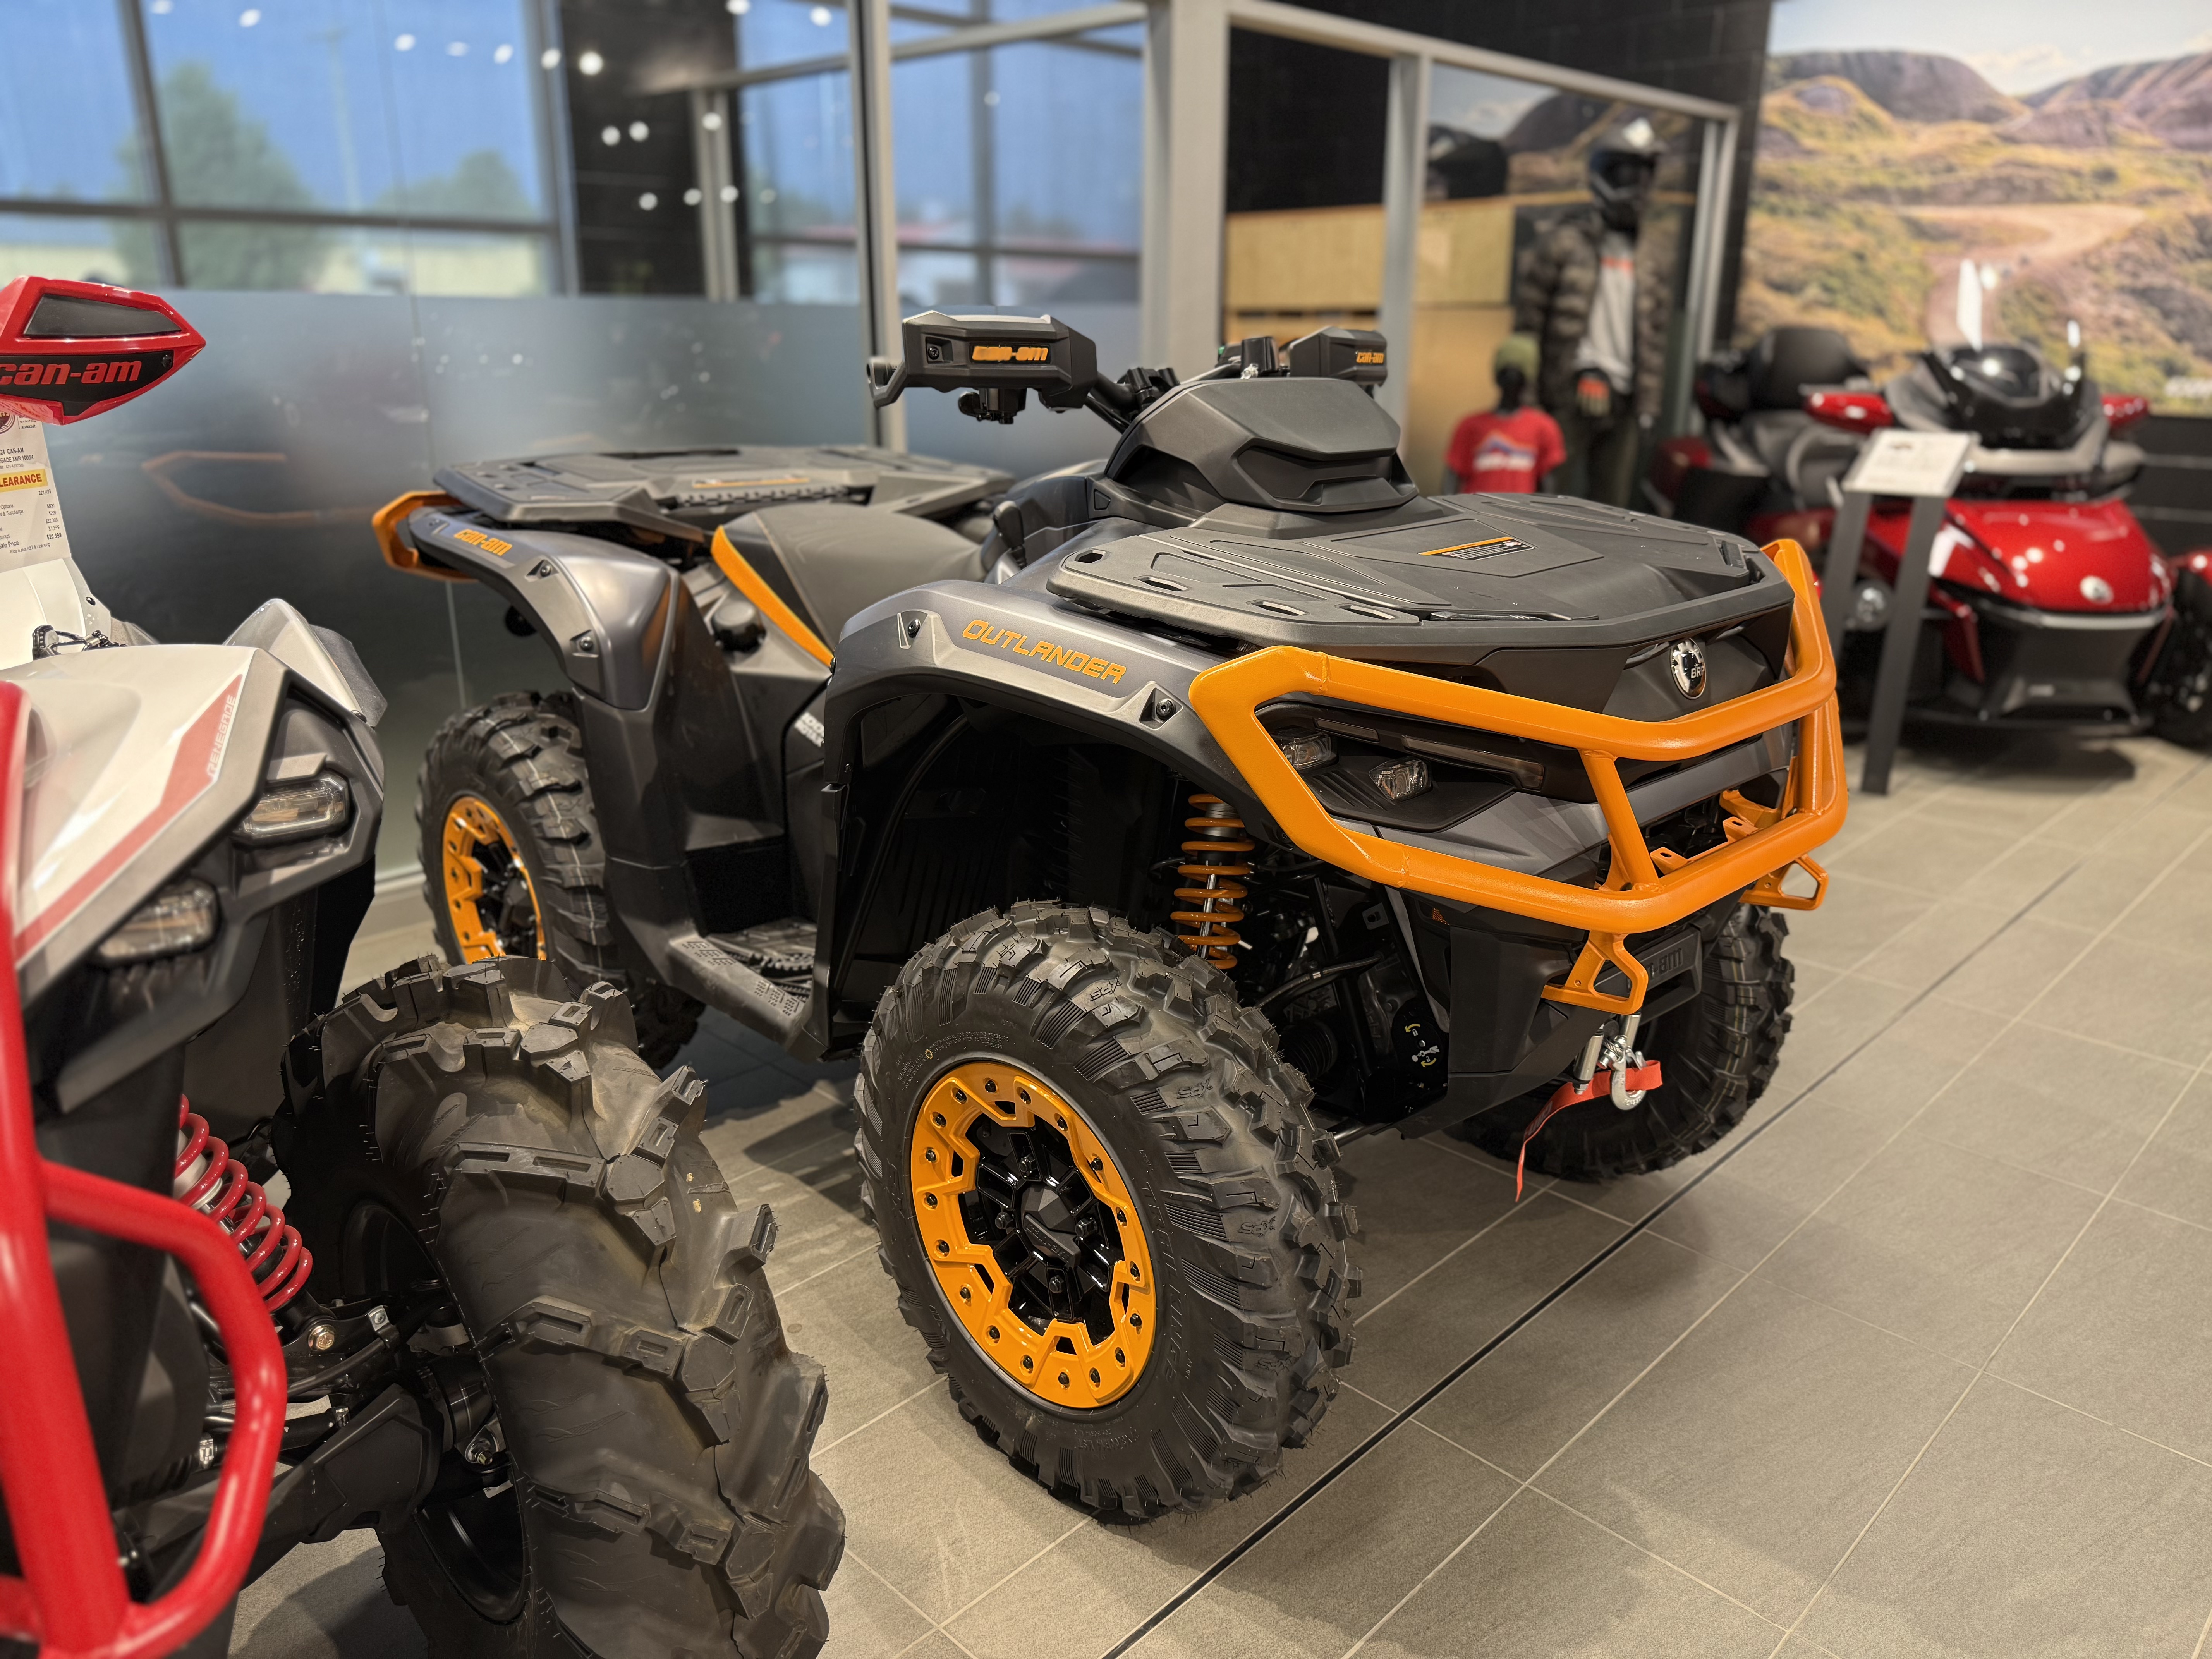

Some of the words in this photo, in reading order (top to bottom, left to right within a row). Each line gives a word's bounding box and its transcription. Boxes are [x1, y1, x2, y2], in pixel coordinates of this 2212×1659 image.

[1356, 352, 1384, 363] can-am
[453, 529, 513, 556] can-am
[962, 619, 1127, 684] OUTLANDER
[1691, 665, 1705, 679] BRP
[206, 694, 236, 776] RENEGADE
